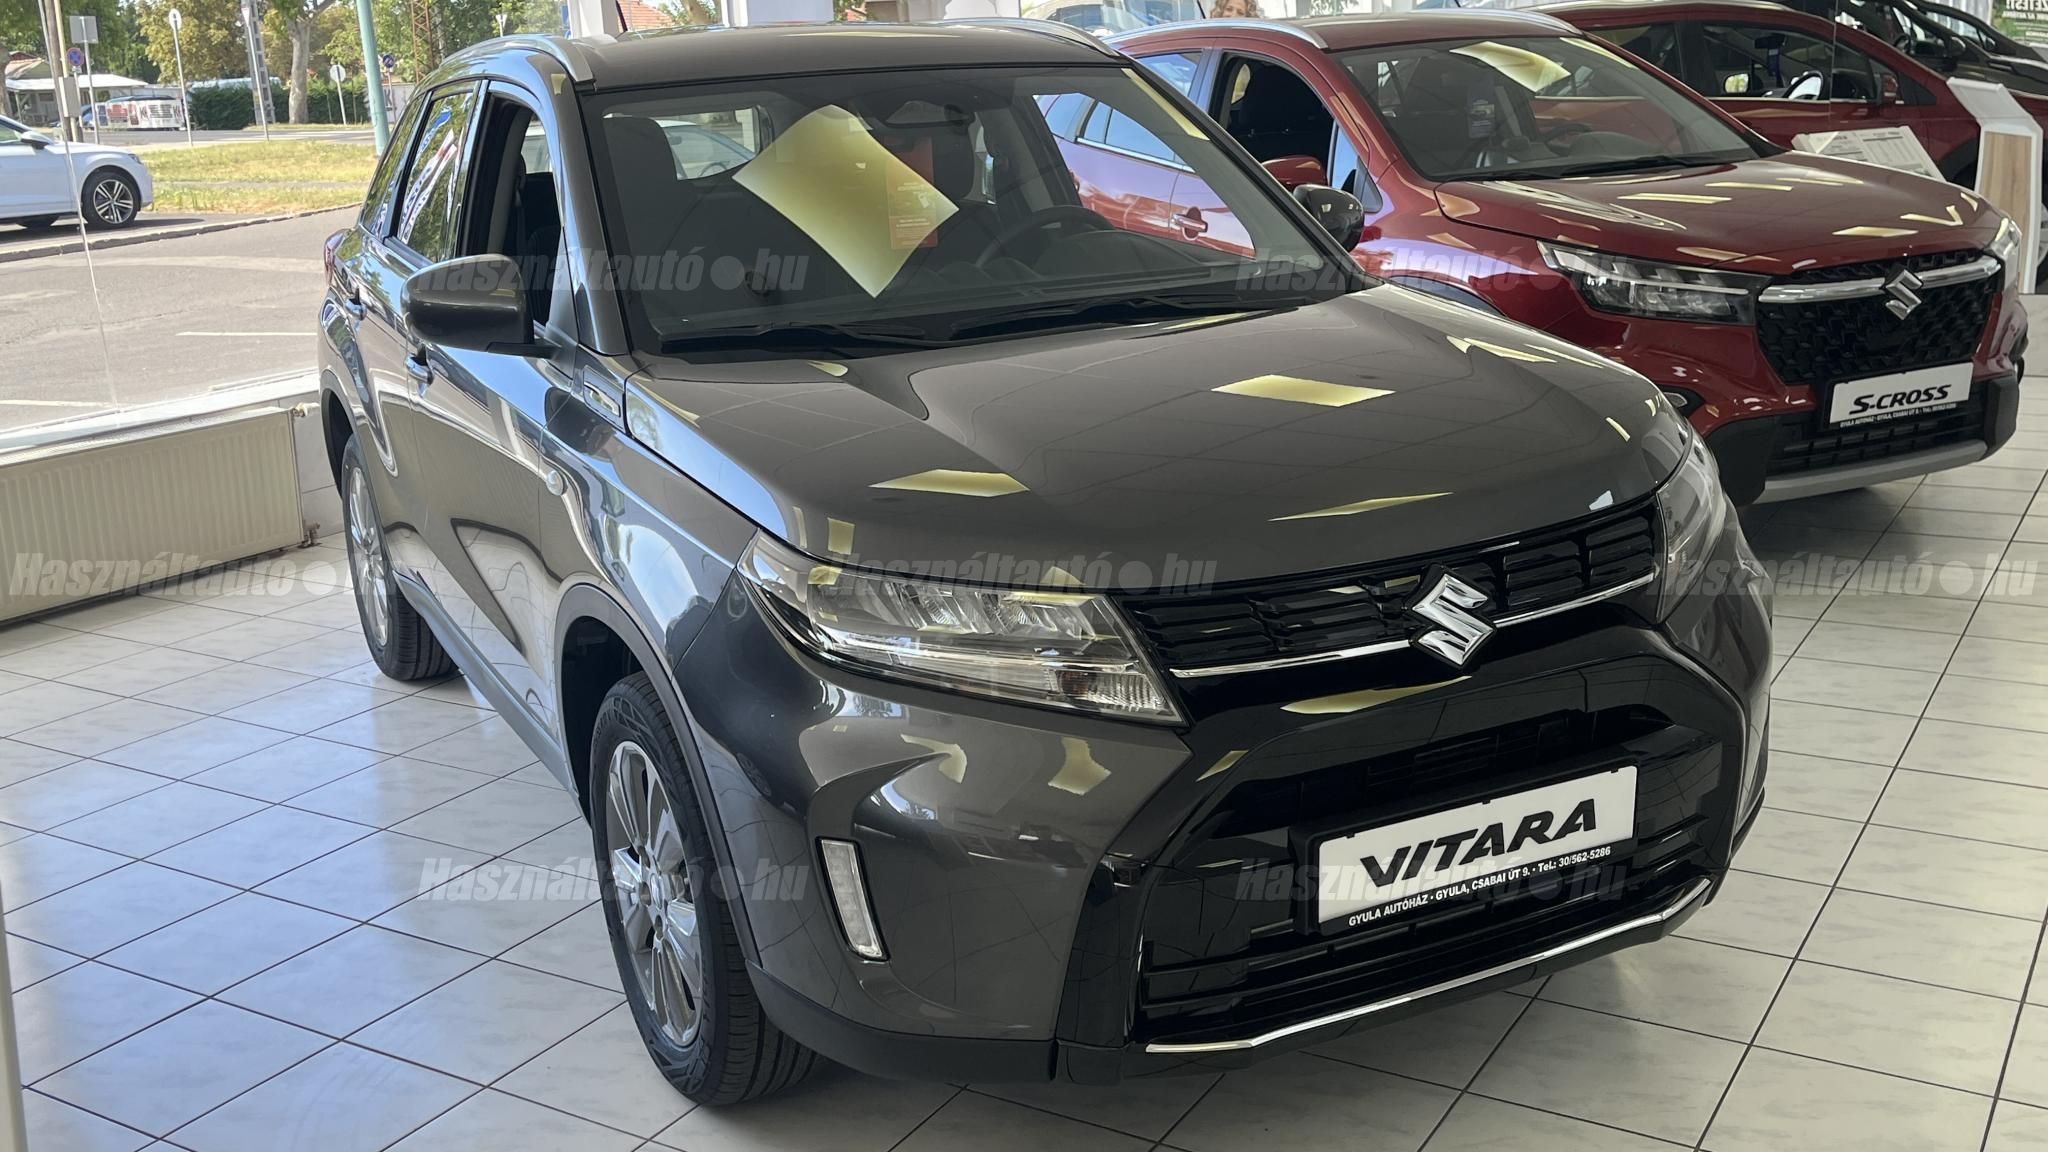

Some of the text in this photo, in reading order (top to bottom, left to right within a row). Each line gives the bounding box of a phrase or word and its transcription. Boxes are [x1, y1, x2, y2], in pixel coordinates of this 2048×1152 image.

[1849, 384, 1952, 415] S-CROSS
[1360, 798, 1596, 887] VITARA
[1348, 908, 1381, 926] GYULA
[1383, 894, 1429, 916] AUTÓHÁZ
[1435, 883, 1470, 901] GYULA,
[1471, 872, 1506, 890] CSABAI
[1508, 867, 1521, 880] ÚT
[1522, 867, 1531, 877] 9.
[1558, 846, 1611, 868] 30/562-5286
